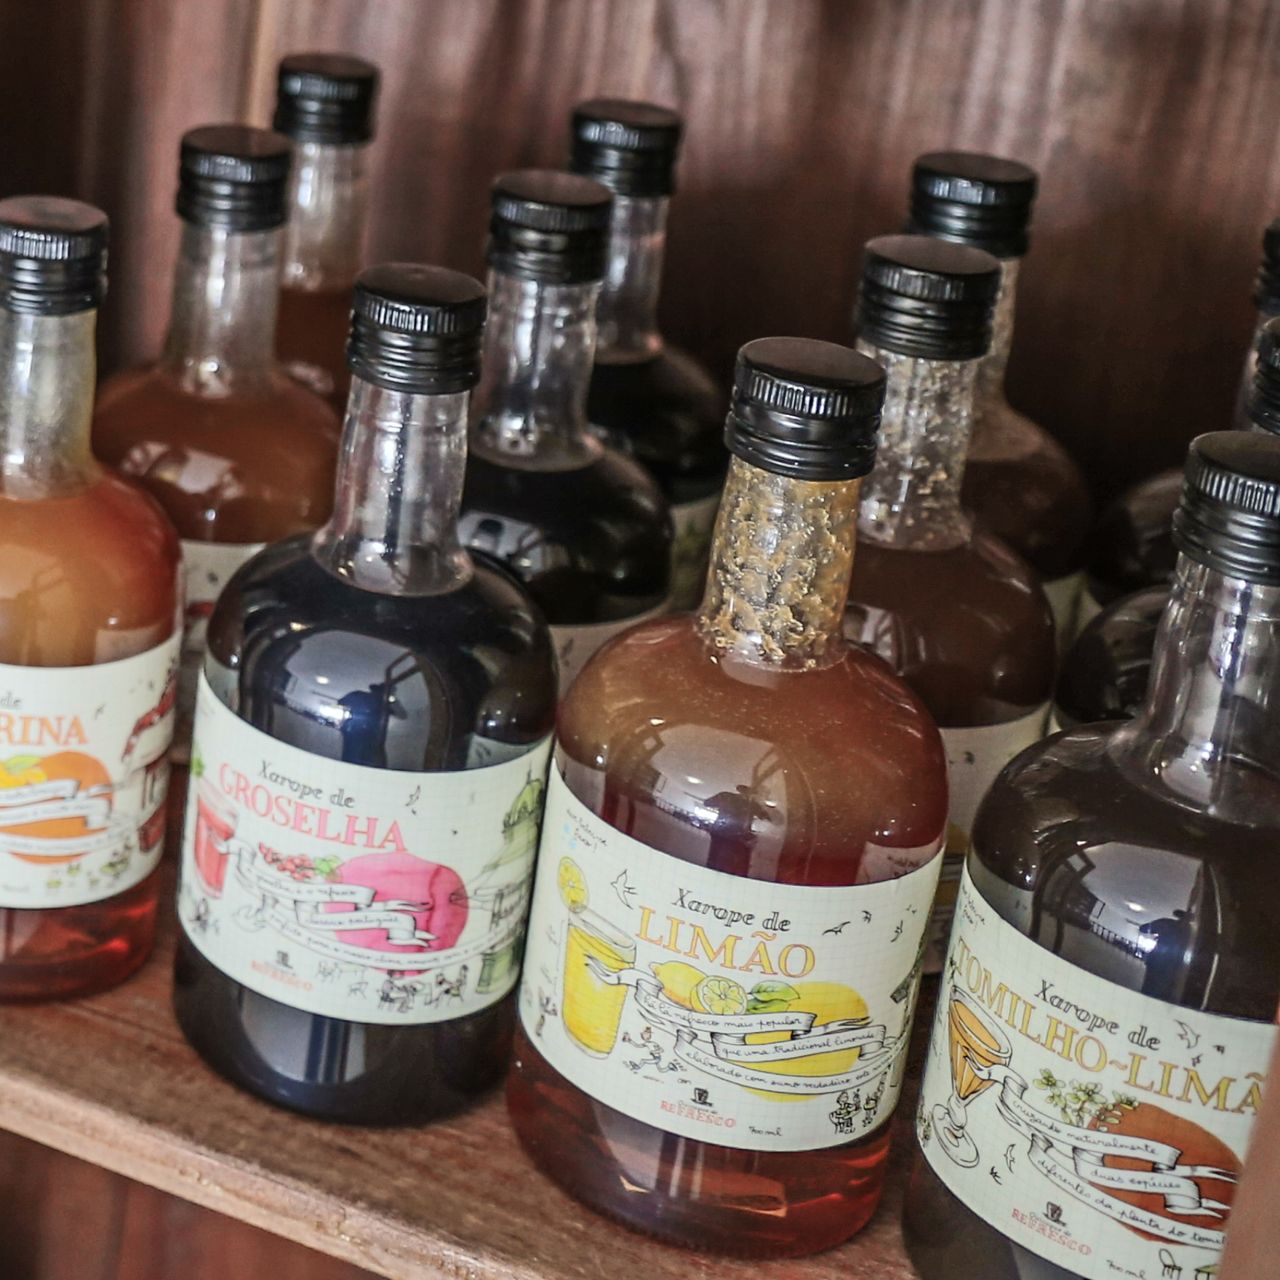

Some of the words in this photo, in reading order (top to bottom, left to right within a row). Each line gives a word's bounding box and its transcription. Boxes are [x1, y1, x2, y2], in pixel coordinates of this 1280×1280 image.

[0, 690, 23, 708] de
[218, 762, 408, 853] GROSELHA
[258, 759, 324, 800] Xarope
[329, 788, 356, 809] de
[671, 887, 755, 928] Xarope
[761, 910, 792, 933] de
[633, 904, 816, 979] LIMÃO
[1034, 978, 1121, 1036] Xarope
[1127, 1024, 1161, 1052] de
[773, 1038, 832, 1055] tradicional
[660, 1100, 737, 1128] REFRESCO
[1066, 1131, 1159, 1155] naturalmente
[1089, 1168, 1125, 1185] duas
[1036, 1158, 1092, 1200] diferentes
[1094, 1198, 1113, 1210] da
[1118, 1209, 1165, 1232] planta
[1190, 1231, 1226, 1246] tomil
[1010, 1207, 1093, 1257] REFRESCO
